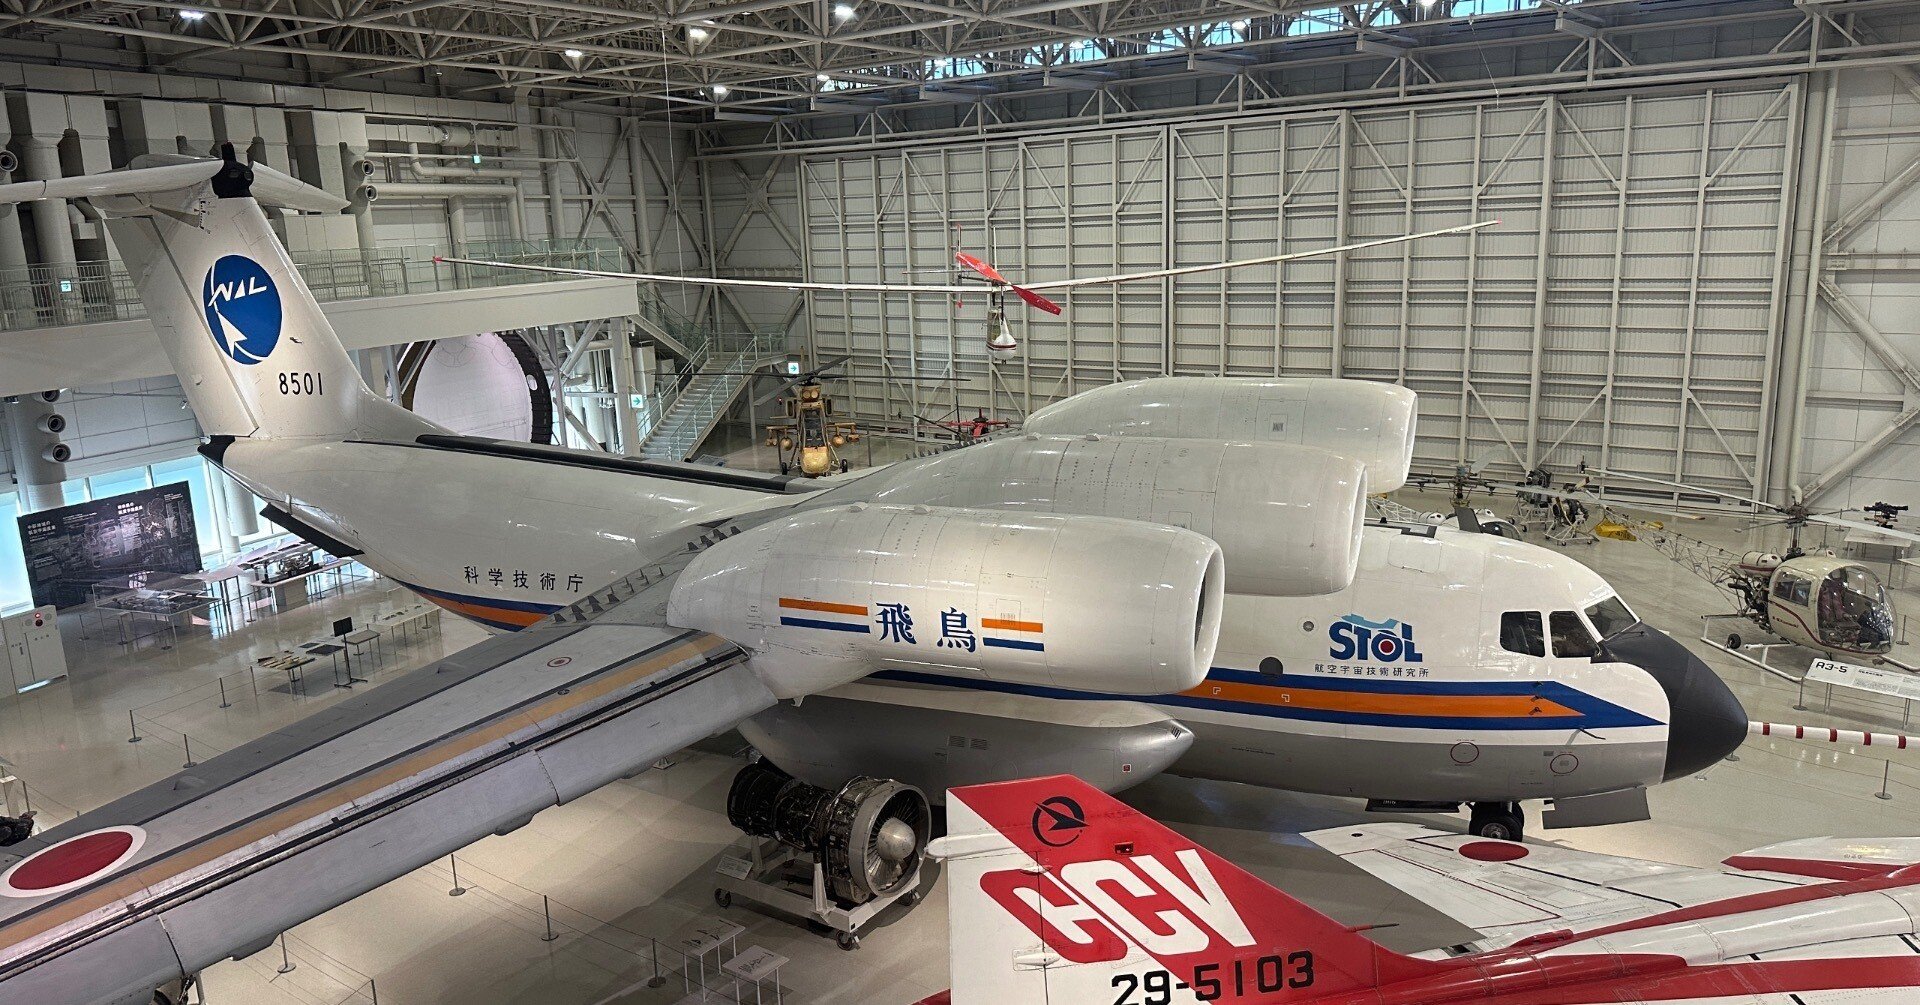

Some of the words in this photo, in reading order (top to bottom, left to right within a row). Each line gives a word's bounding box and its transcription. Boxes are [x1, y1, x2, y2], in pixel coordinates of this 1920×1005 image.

[208, 277, 267, 307] NAL
[278, 372, 323, 396] 8501
[464, 565, 583, 593] 科学技術庁
[1328, 621, 1423, 662] STOL
[1314, 663, 1429, 678] 航空宇宙技術研究所
[979, 848, 1257, 963] CCV
[1111, 950, 1315, 1005] 29-5103
